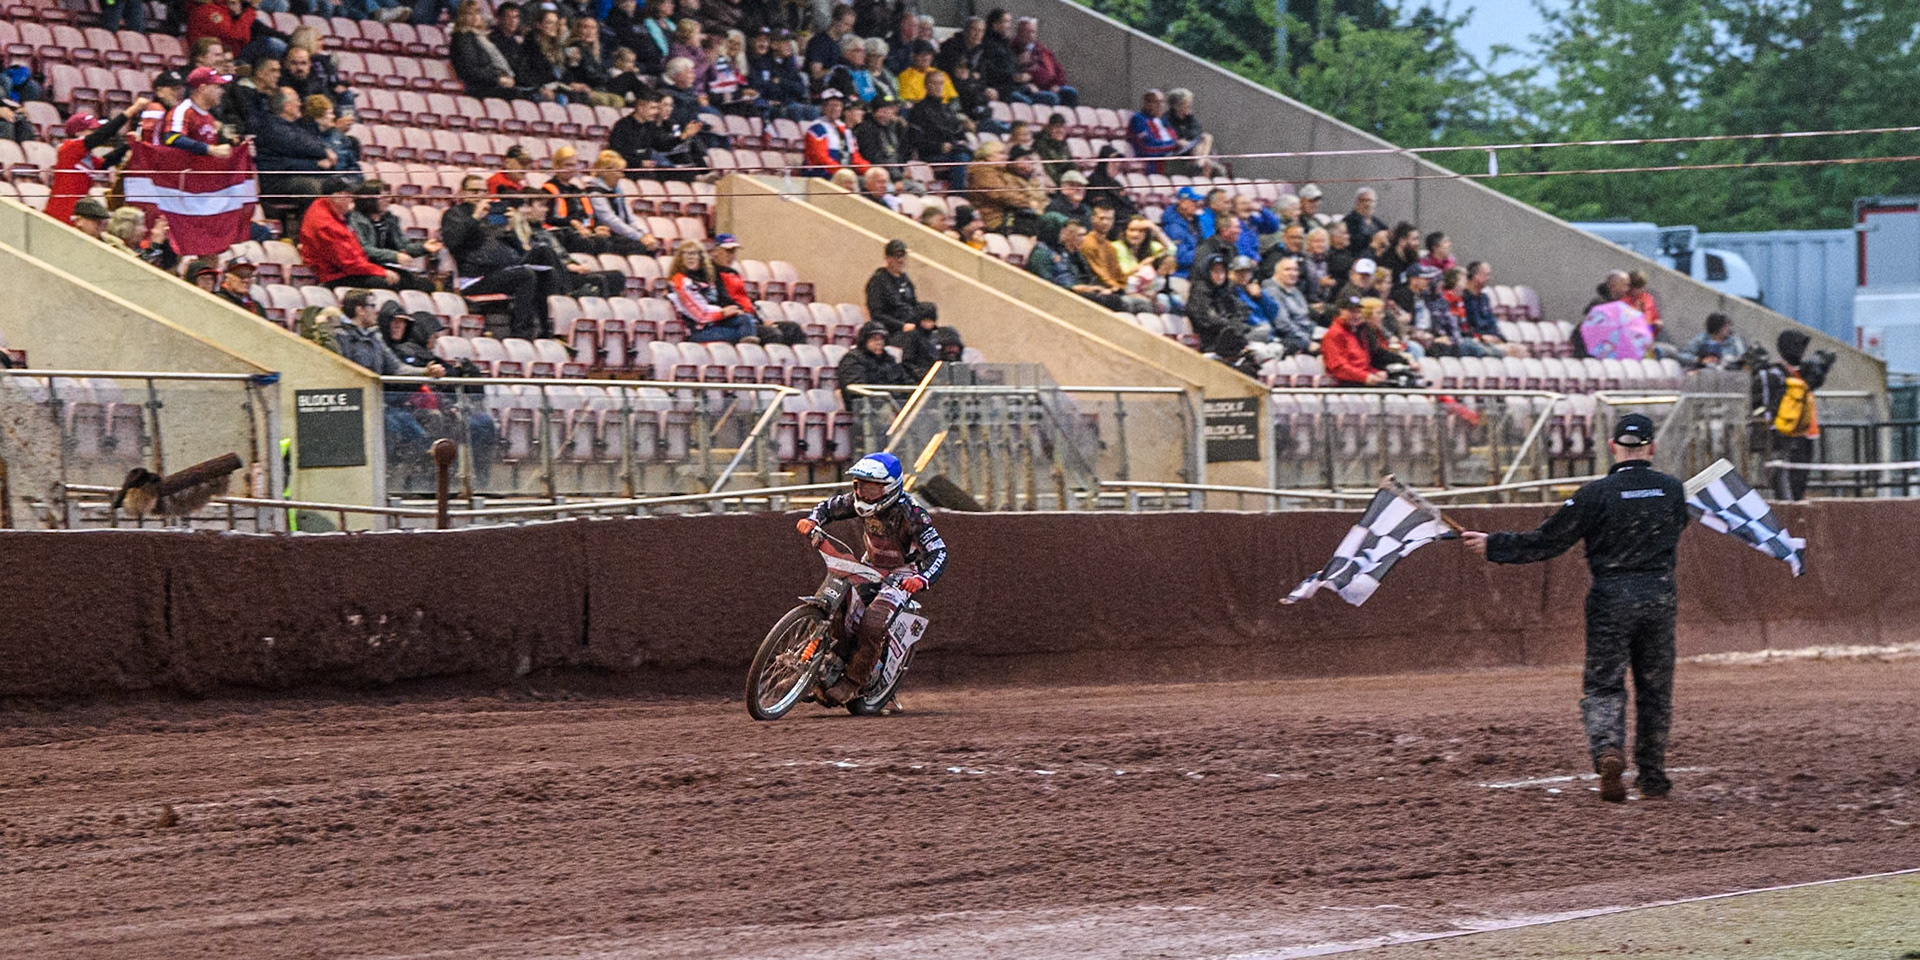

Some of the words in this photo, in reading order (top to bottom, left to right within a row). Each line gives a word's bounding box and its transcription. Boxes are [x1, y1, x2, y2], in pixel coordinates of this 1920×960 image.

[298, 394, 337, 407] BLOCK
[337, 393, 348, 405] E
[1620, 488, 1666, 500] MARSHAL
